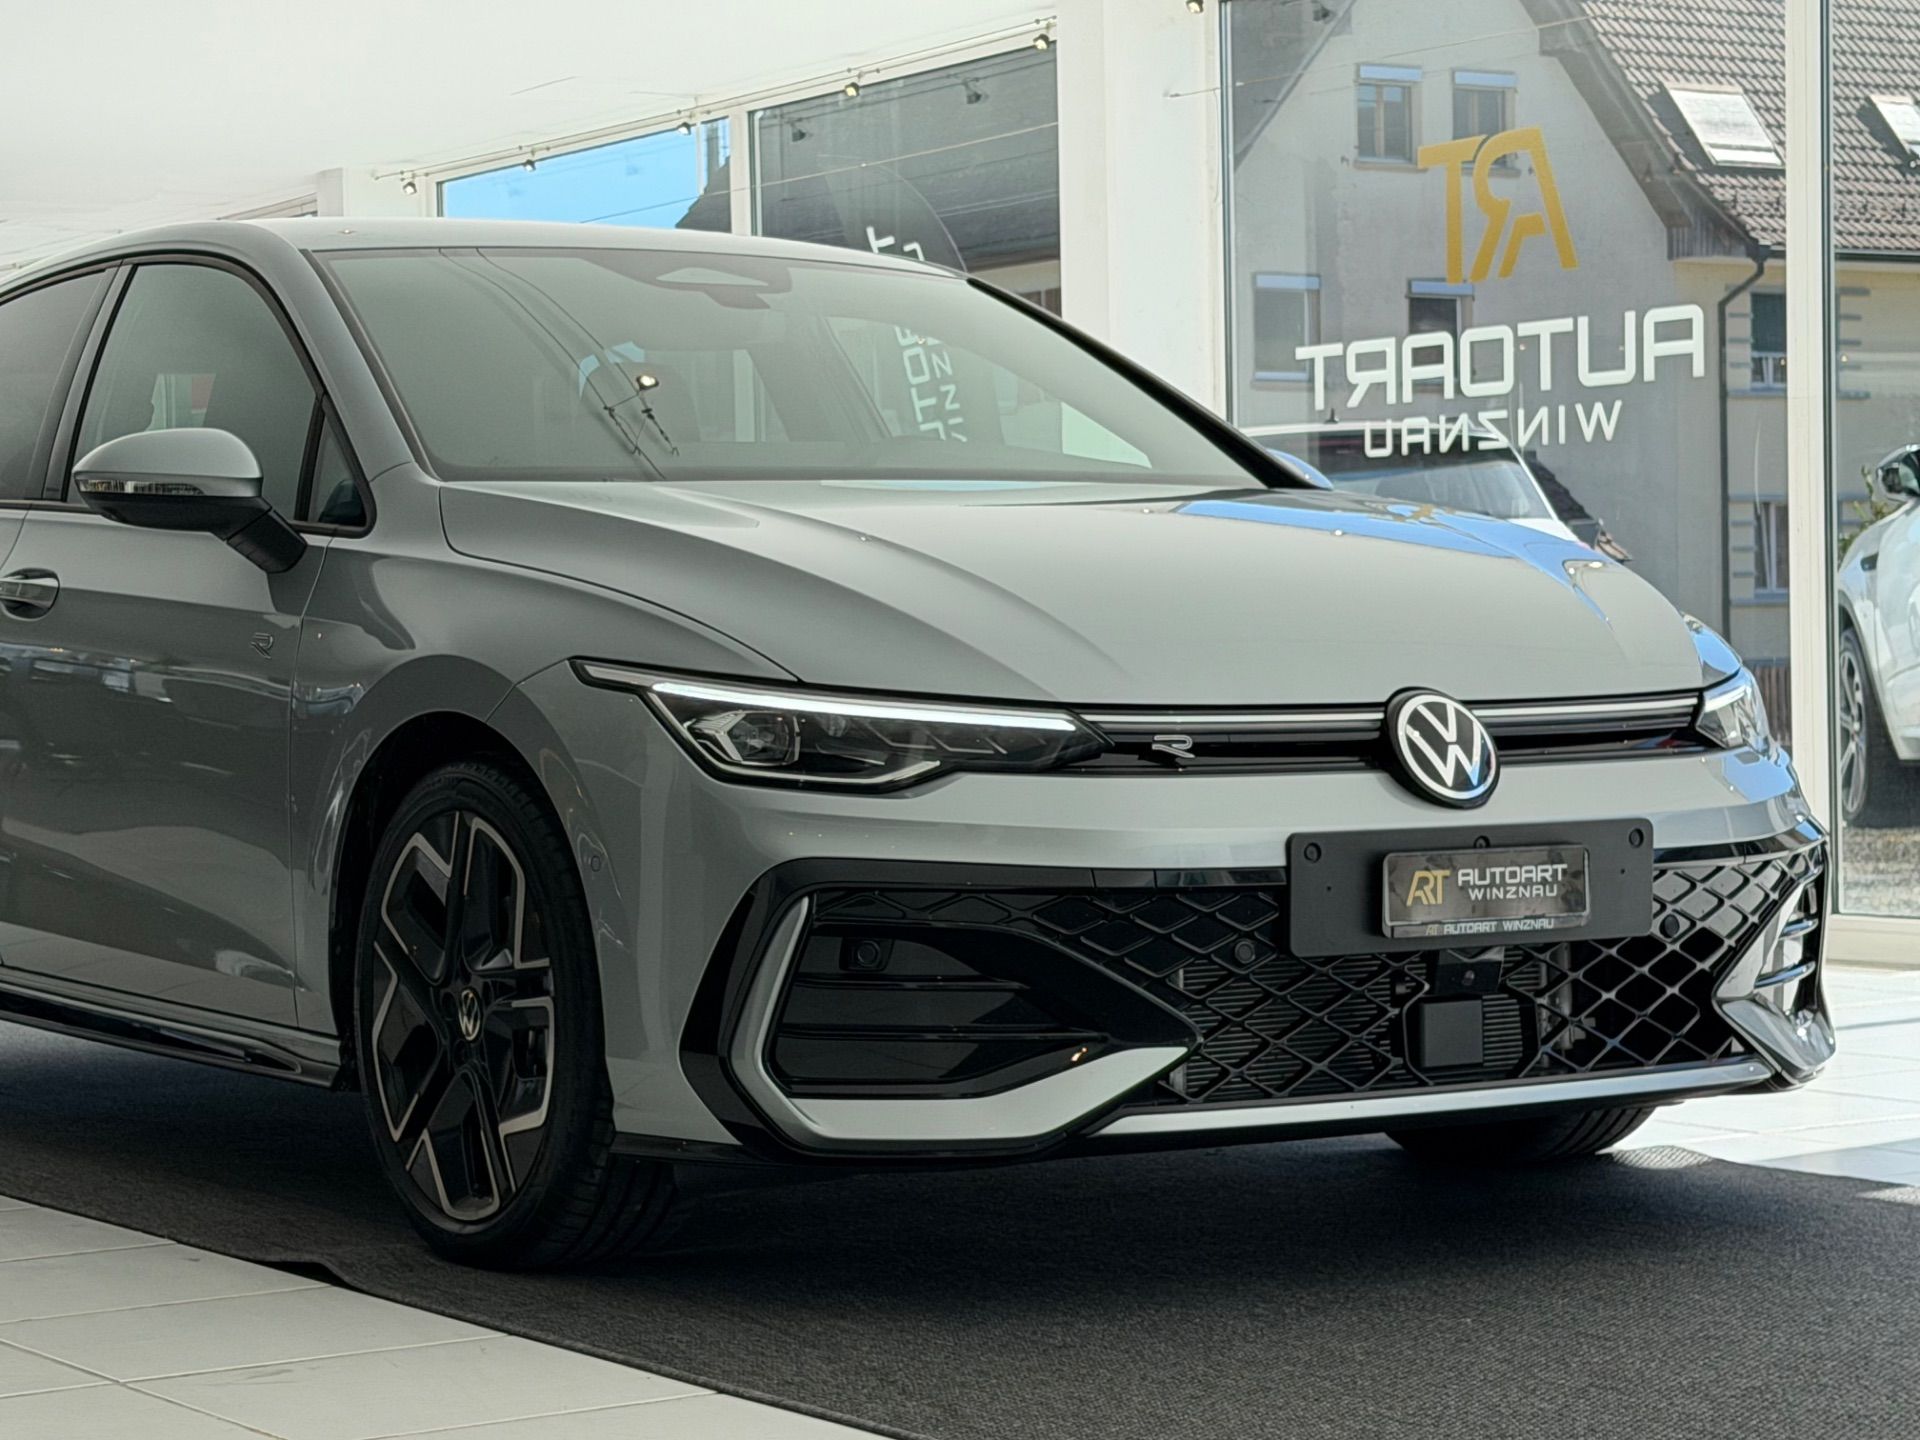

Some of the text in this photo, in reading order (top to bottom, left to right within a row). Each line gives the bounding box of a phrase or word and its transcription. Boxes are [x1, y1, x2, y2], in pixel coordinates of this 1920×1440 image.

[1457, 863, 1568, 887] AUTOART
[1468, 884, 1559, 901] WINZNAU
[1443, 920, 1498, 935] AUTOART
[1502, 917, 1555, 932] WINZNAU
